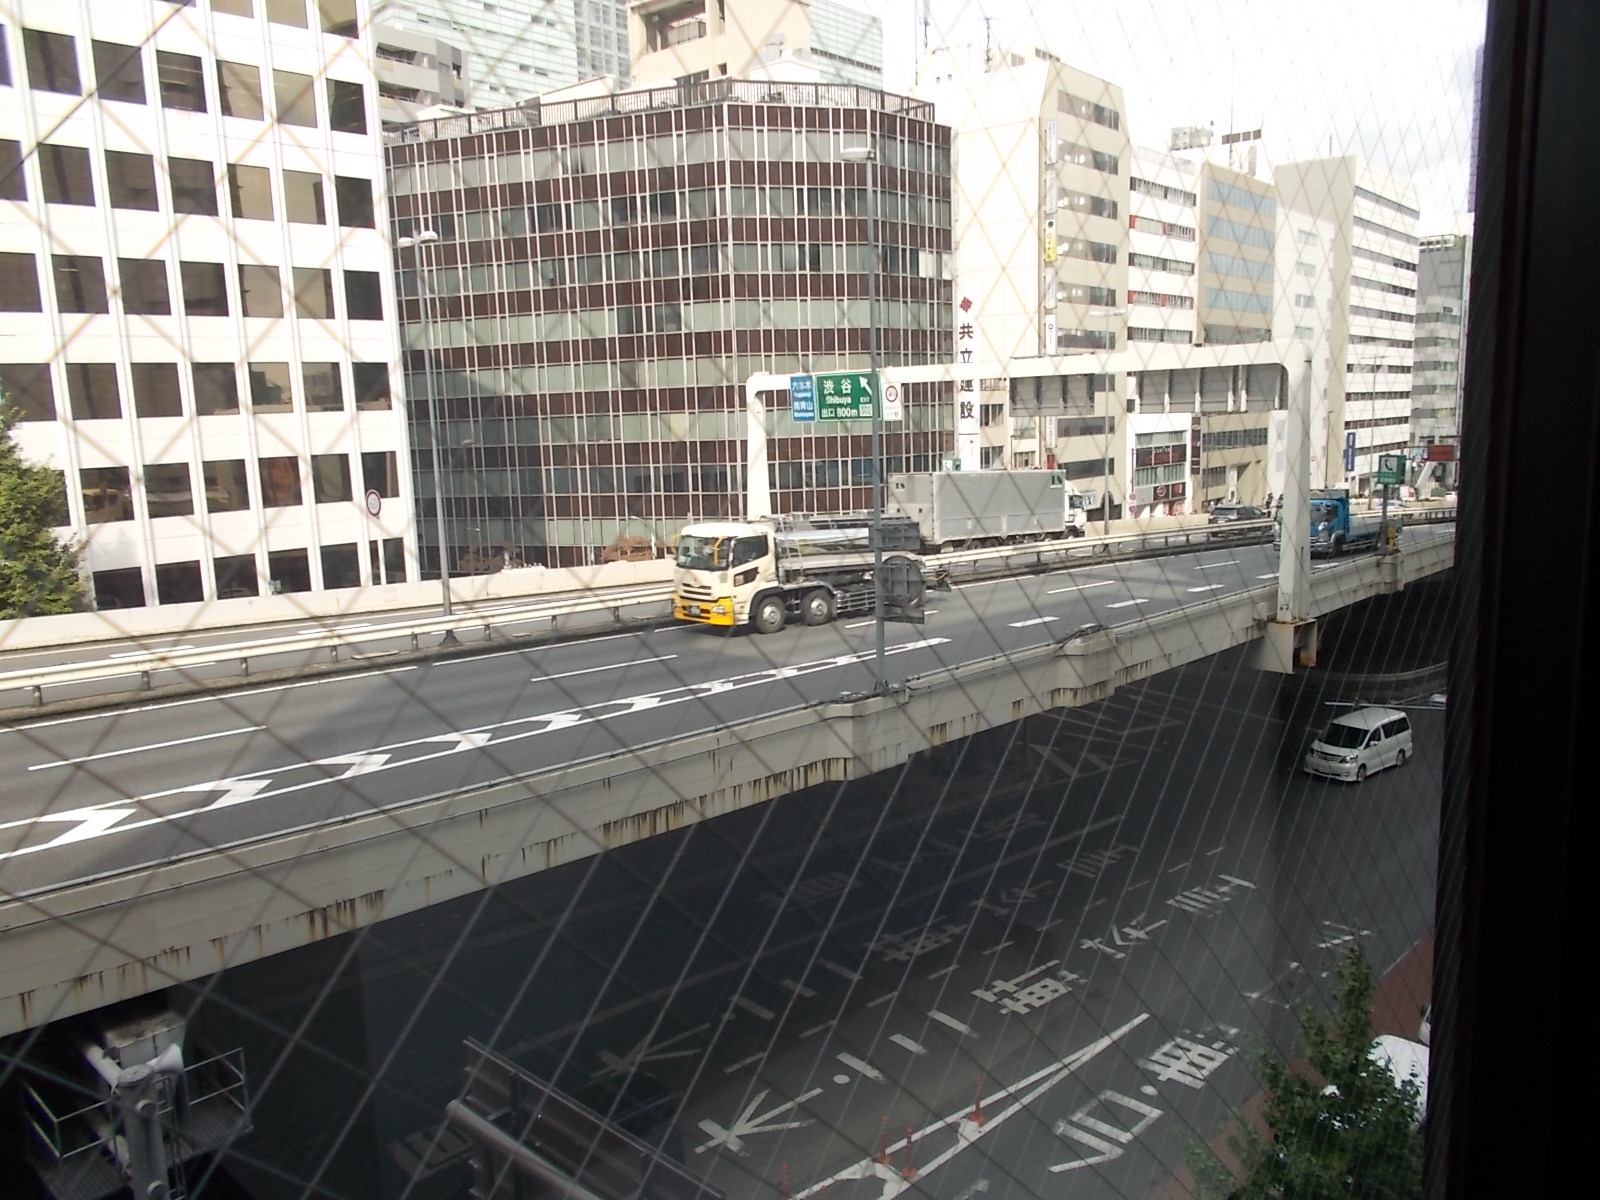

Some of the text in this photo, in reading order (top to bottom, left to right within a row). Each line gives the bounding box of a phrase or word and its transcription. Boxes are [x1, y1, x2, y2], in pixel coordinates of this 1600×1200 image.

[823, 378, 852, 394] 渋谷
[825, 395, 852, 405] Shibuya
[821, 408, 835, 418] 出口
